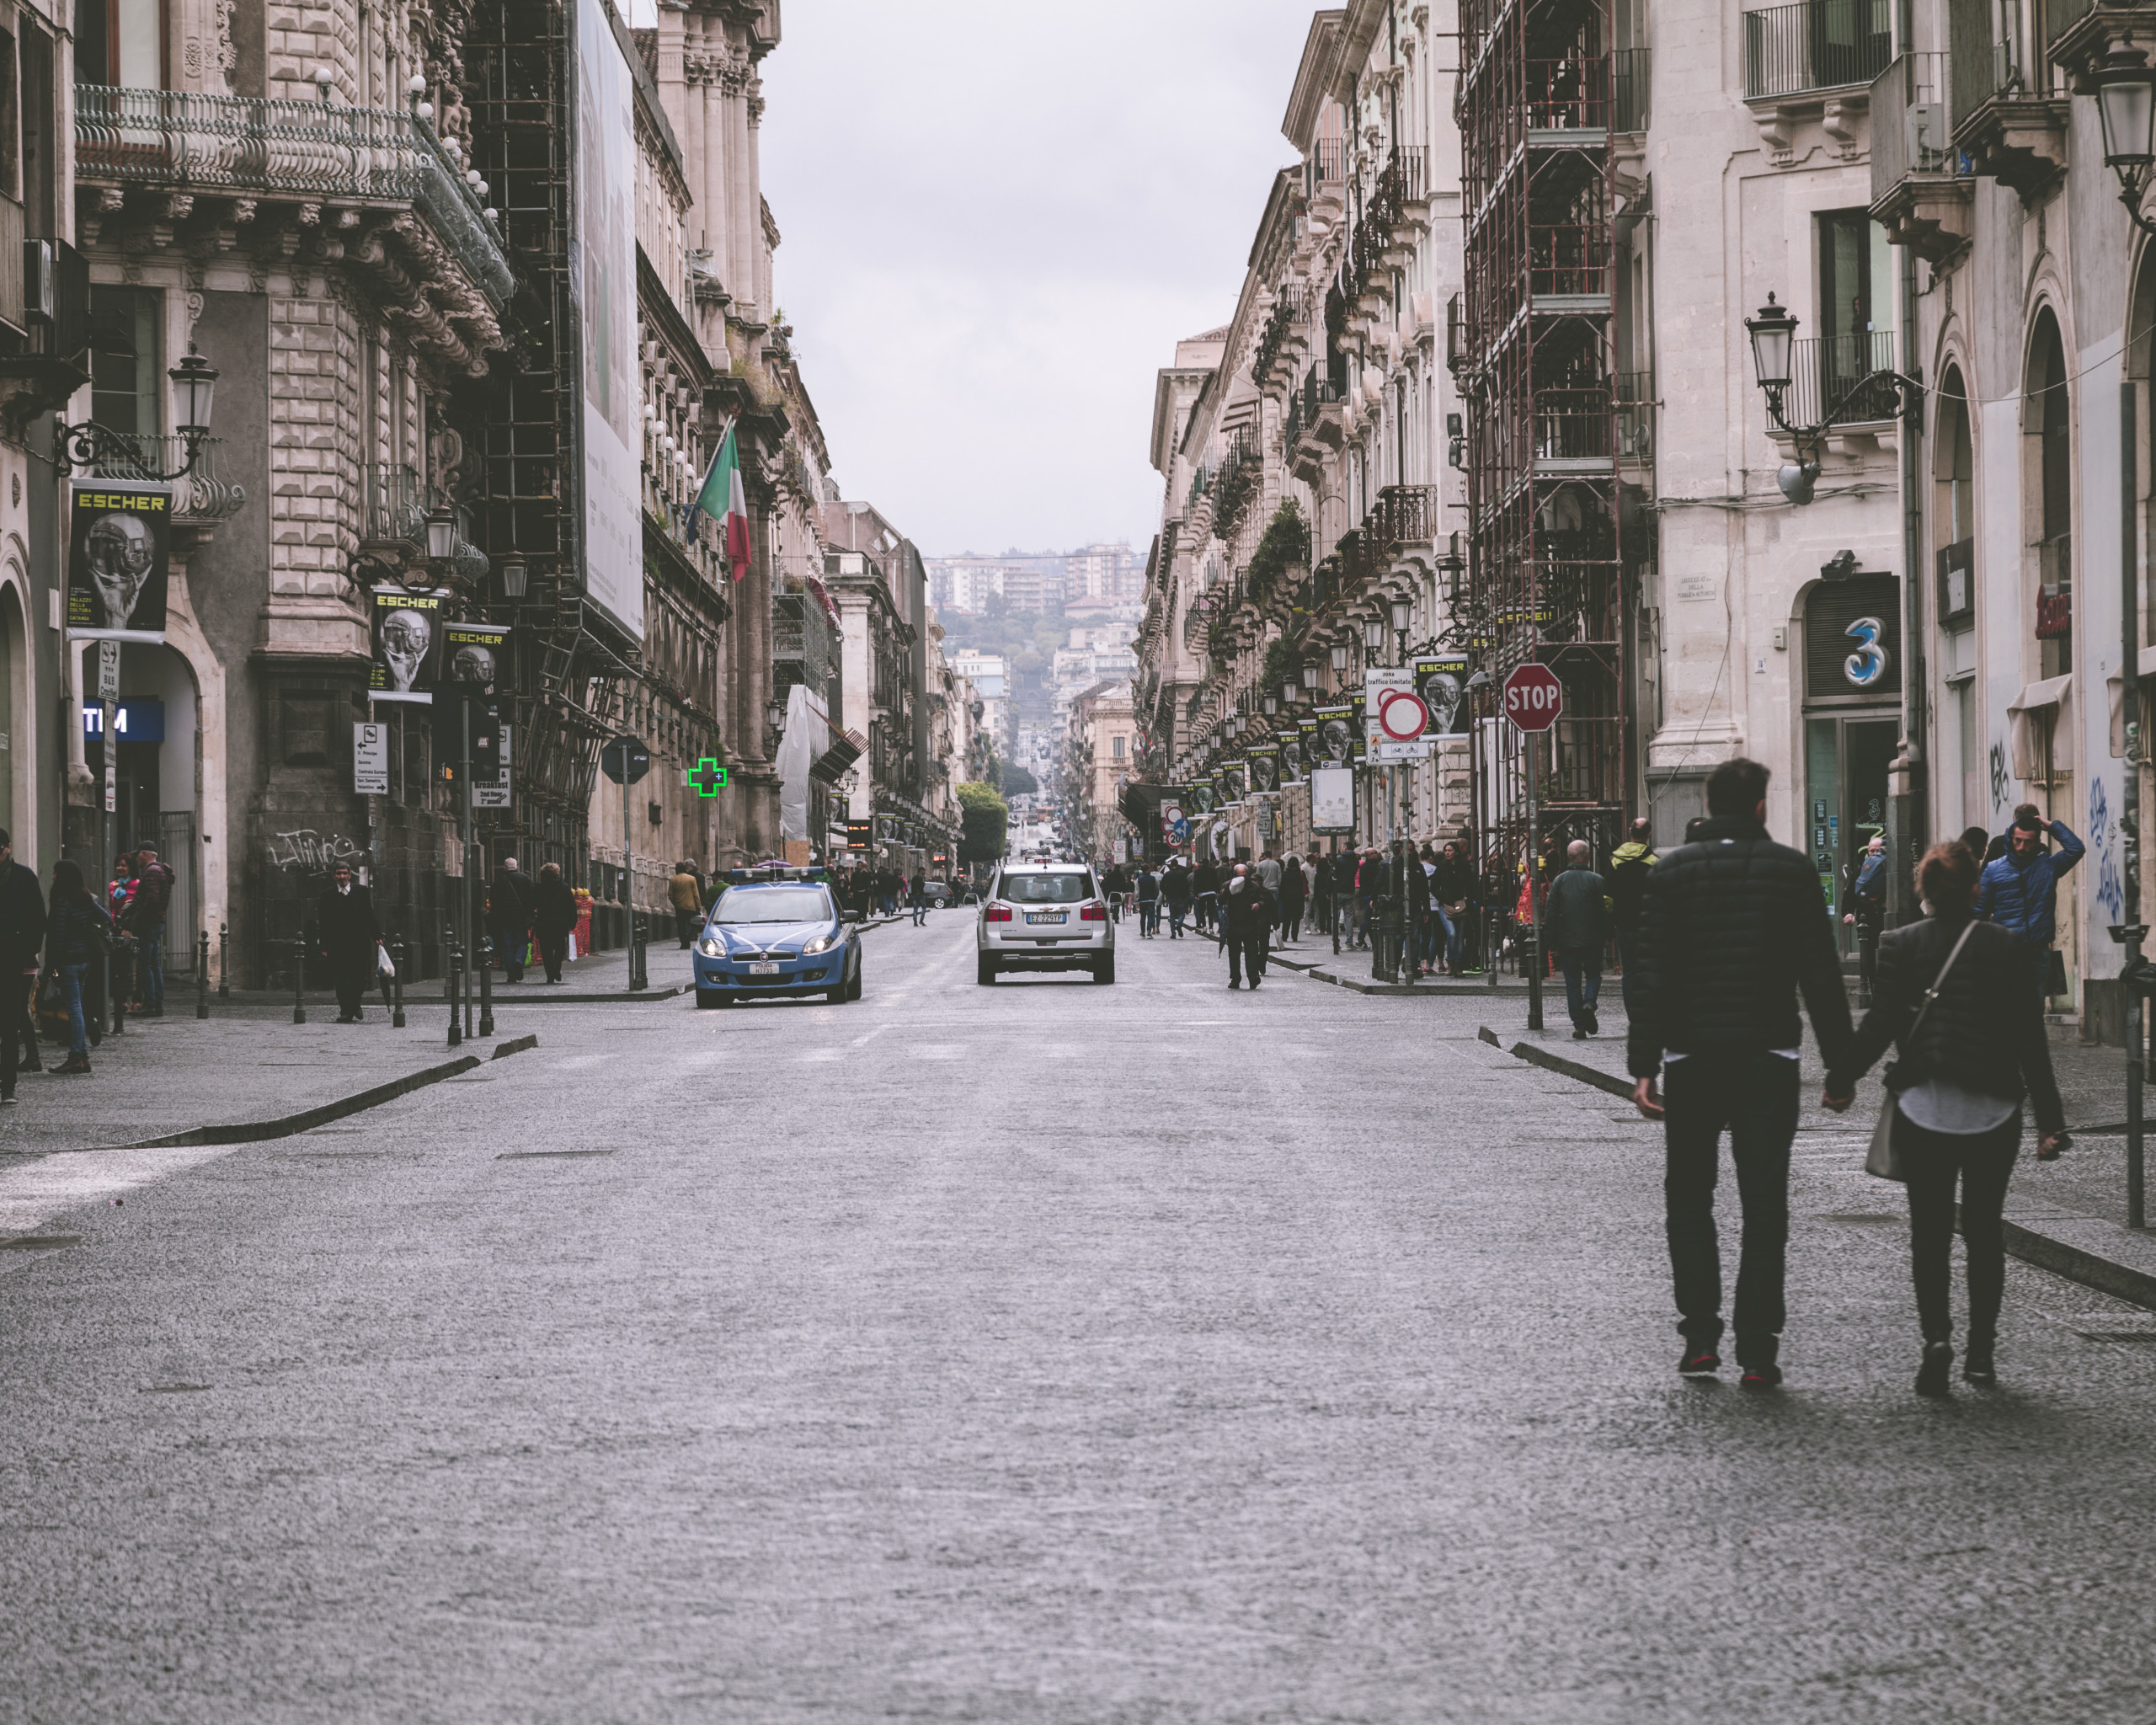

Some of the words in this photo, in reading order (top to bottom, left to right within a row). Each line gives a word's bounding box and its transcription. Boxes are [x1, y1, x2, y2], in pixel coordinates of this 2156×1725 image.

[79, 494, 165, 511] ESCHER
[376, 595, 439, 609] ESCHER
[450, 633, 503, 644] ESCHER
[1844, 617, 1886, 686] 3
[1419, 663, 1465, 672] ESCHER
[104, 674, 115, 686] B&B
[1508, 685, 1558, 711] STOP
[1318, 712, 1353, 720] ESCHER
[474, 781, 509, 789] Breakfast
[1171, 834, 1181, 844] 20
[1032, 914, 1039, 922] EZ
[1041, 914, 1062, 922] 229YP
